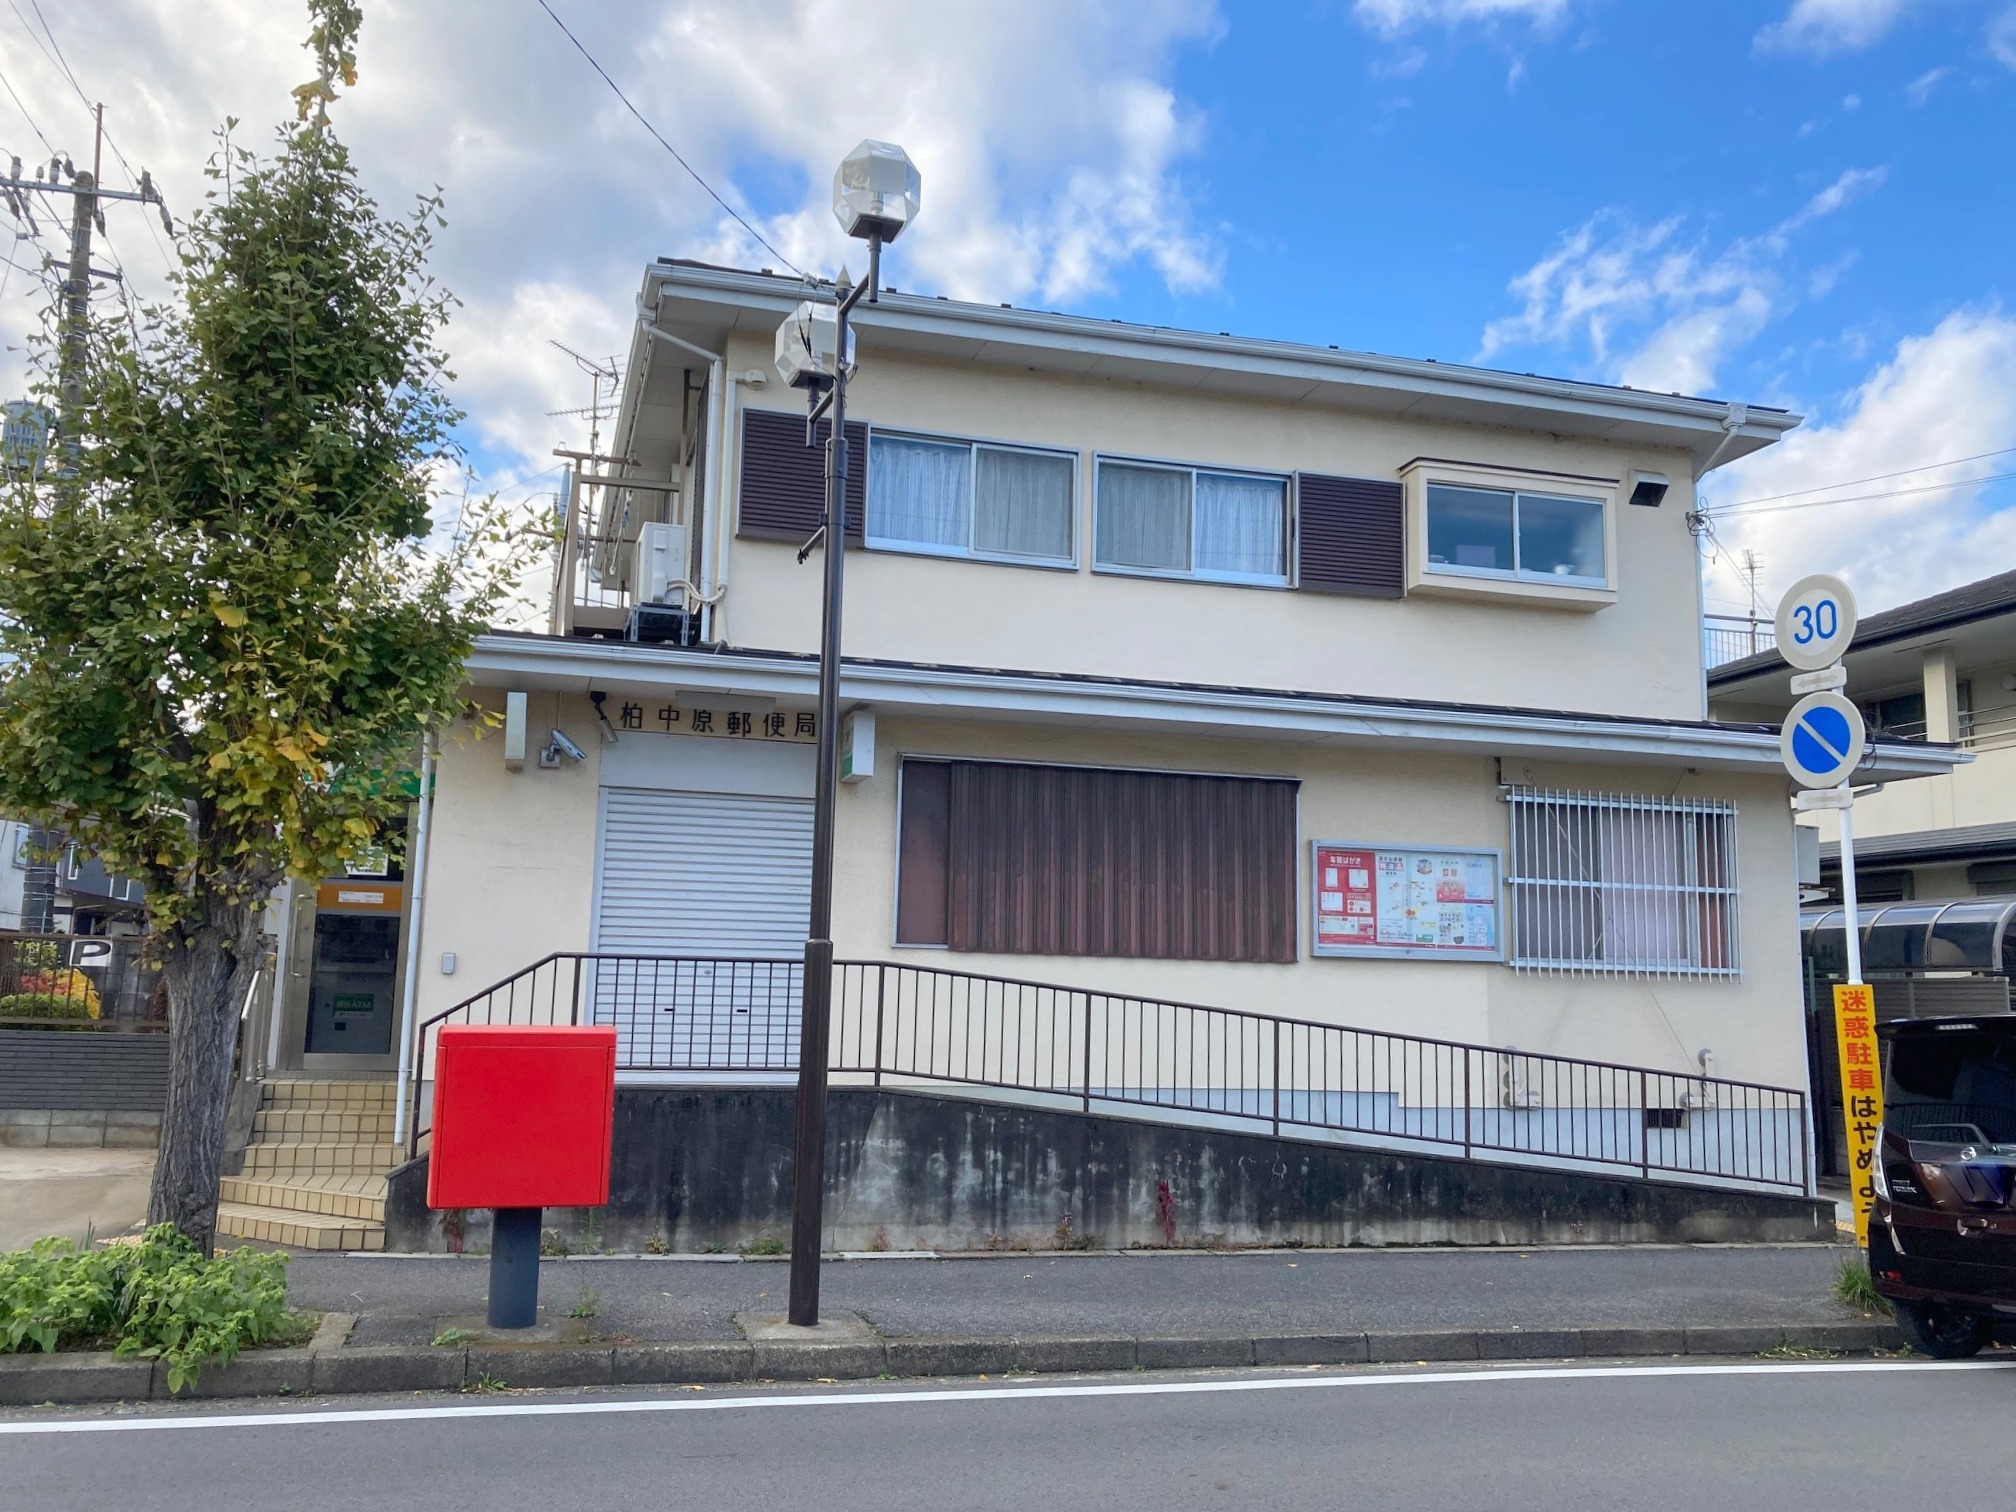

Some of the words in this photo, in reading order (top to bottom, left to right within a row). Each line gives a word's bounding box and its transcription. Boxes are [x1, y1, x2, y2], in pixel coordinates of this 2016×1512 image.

[1794, 600, 1837, 644] 30
[620, 701, 816, 738] 柏中原郵便局
[72, 941, 111, 965] P
